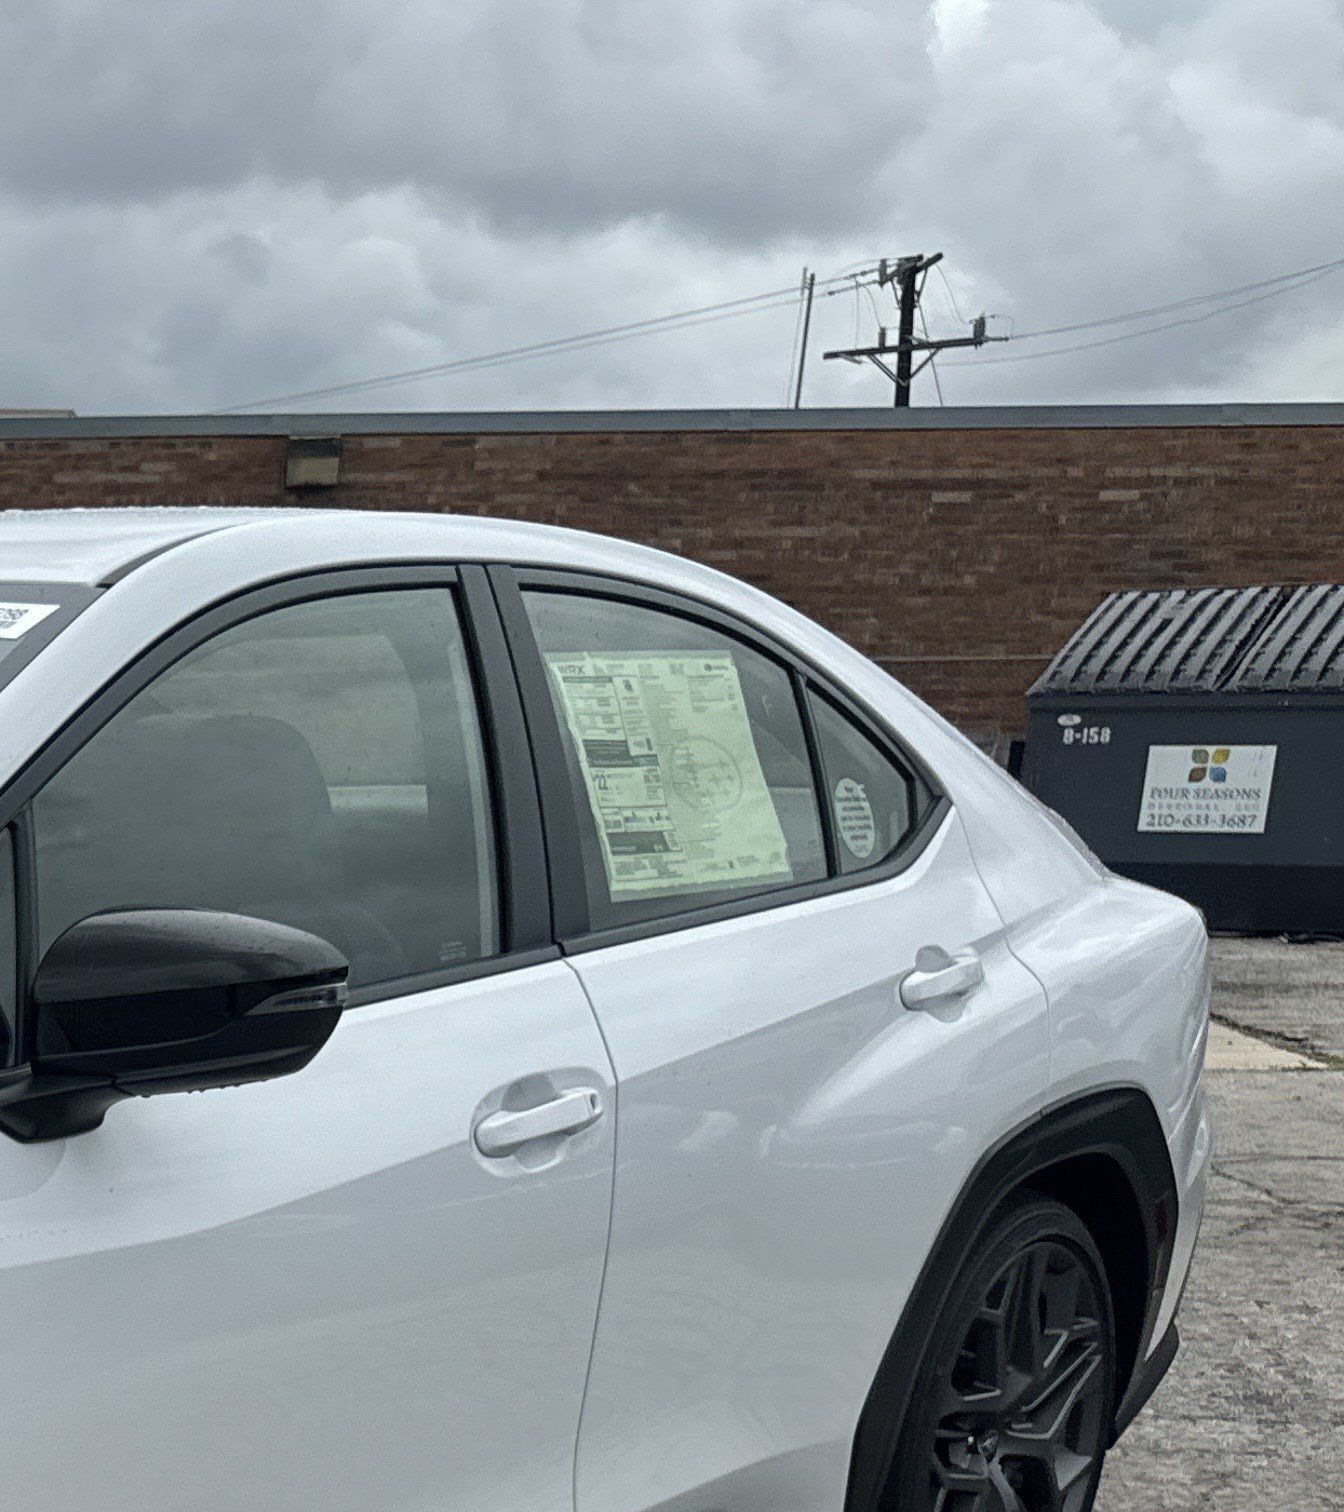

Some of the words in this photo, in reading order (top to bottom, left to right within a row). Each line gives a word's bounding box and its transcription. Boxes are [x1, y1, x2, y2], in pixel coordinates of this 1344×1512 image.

[1063, 727, 1111, 745] B-158
[1149, 787, 1189, 800] FOUR
[1193, 787, 1261, 800] SEASONS
